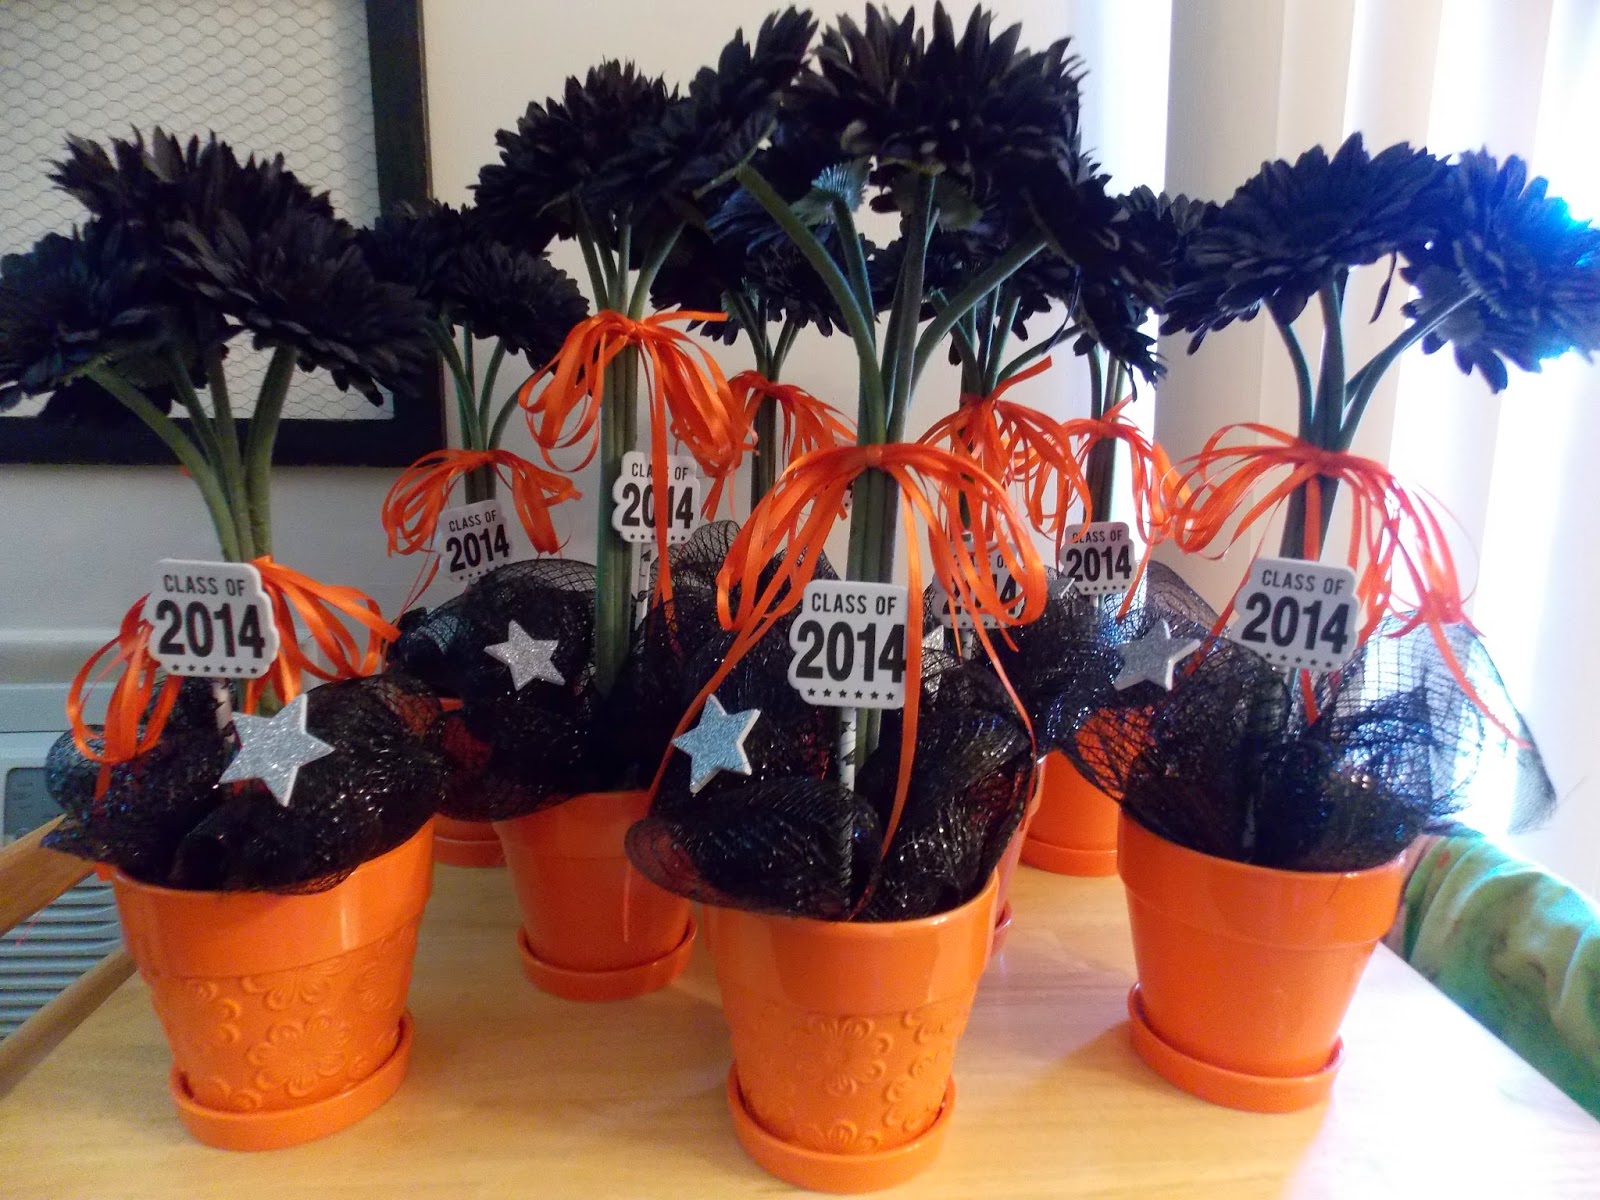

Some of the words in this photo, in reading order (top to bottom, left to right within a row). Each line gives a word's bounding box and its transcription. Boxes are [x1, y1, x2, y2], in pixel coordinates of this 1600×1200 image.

[675, 467, 688, 481] OF
[448, 514, 482, 532] CLASS
[484, 510, 497, 523] OF
[446, 524, 510, 573] 2014
[1110, 530, 1123, 541] OF
[1066, 544, 1132, 582] 2014
[163, 574, 218, 596] CLASS
[226, 578, 245, 597] OF
[1262, 569, 1316, 593] CLASS
[1323, 578, 1346, 596] OF
[811, 592, 867, 615] CLASS
[875, 596, 898, 616] OF
[156, 600, 266, 659] 2014
[1241, 592, 1350, 655] 2014
[796, 620, 908, 684] 2014
